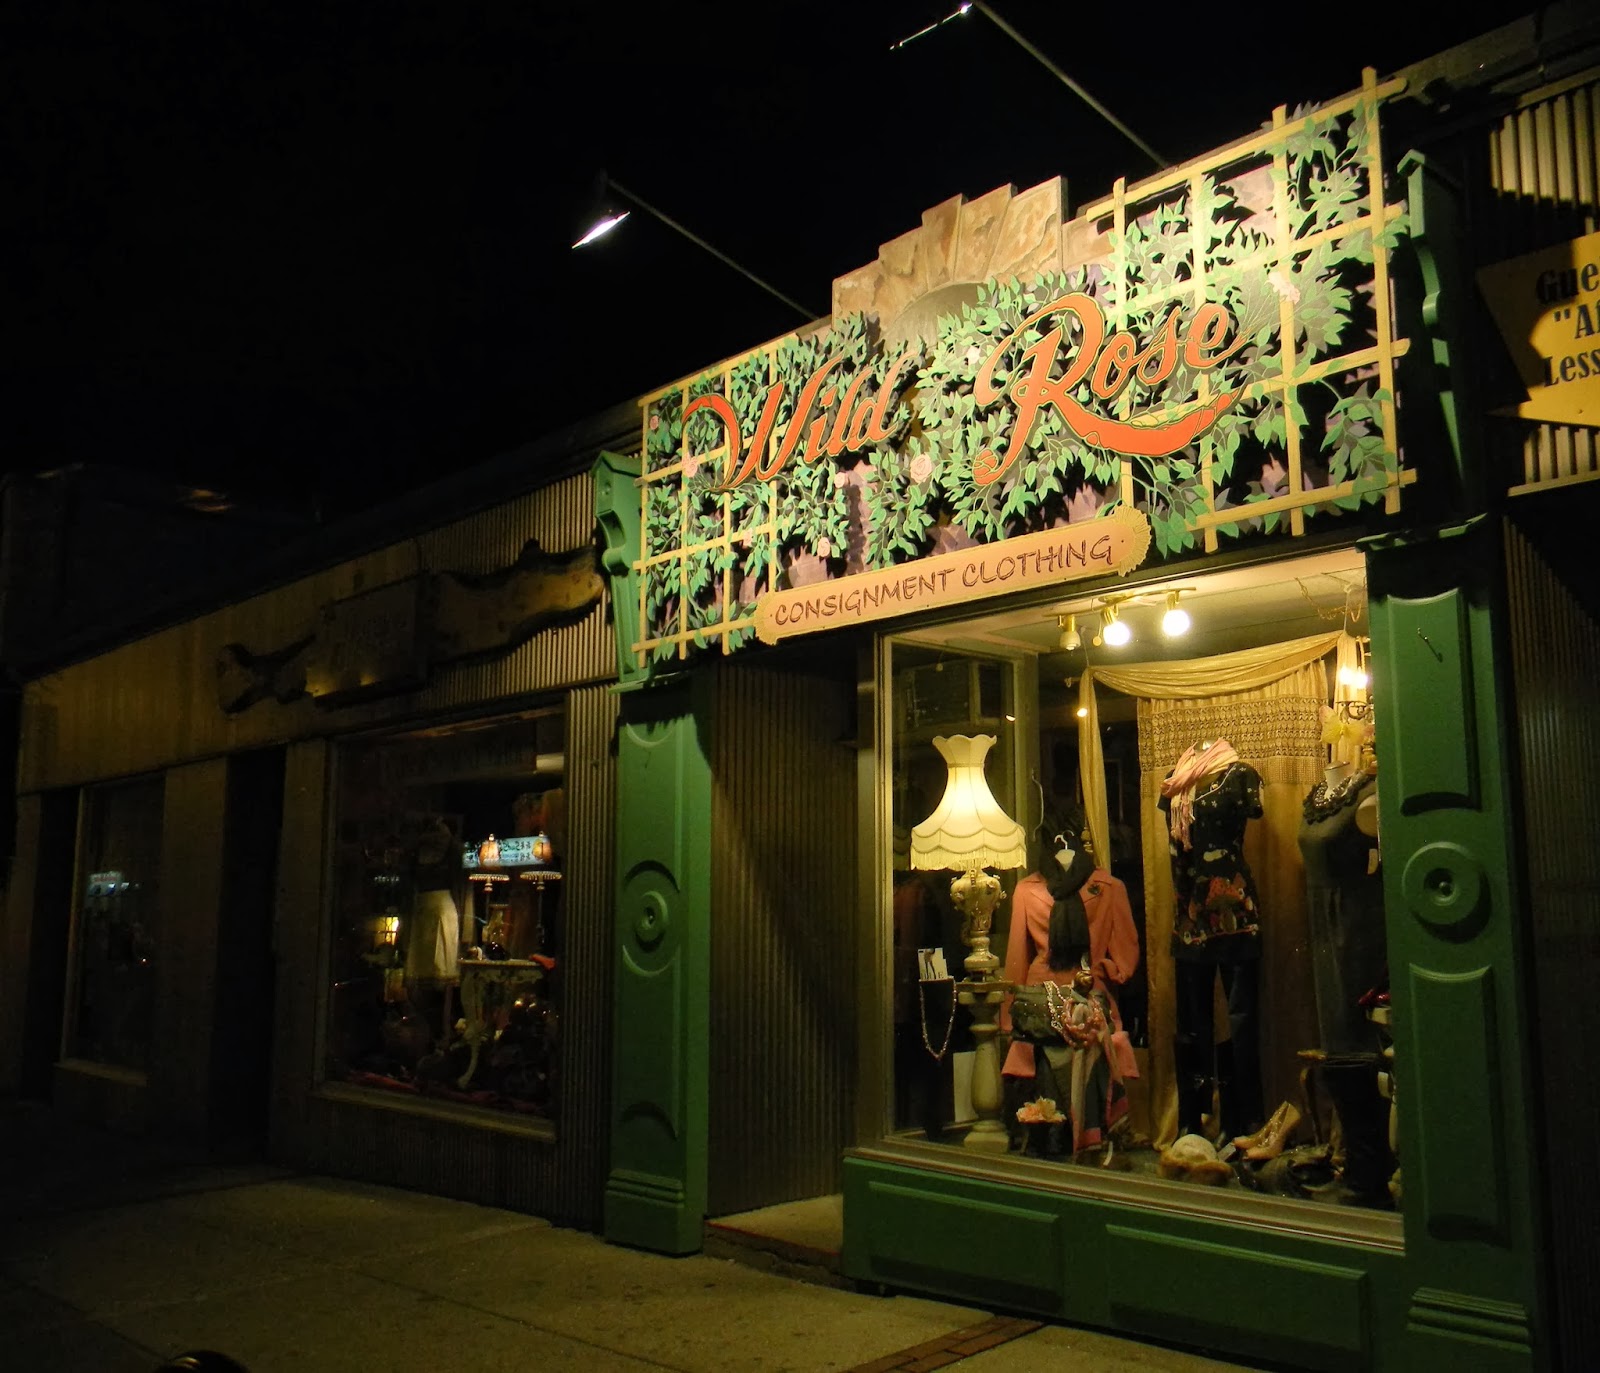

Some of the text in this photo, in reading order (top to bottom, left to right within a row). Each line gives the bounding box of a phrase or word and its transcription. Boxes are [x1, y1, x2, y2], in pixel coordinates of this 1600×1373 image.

[1537, 258, 1600, 303] Gue
[682, 292, 1250, 491] Wild Rose
[775, 534, 1114, 626] CONSIGNMENT CLOTHING
